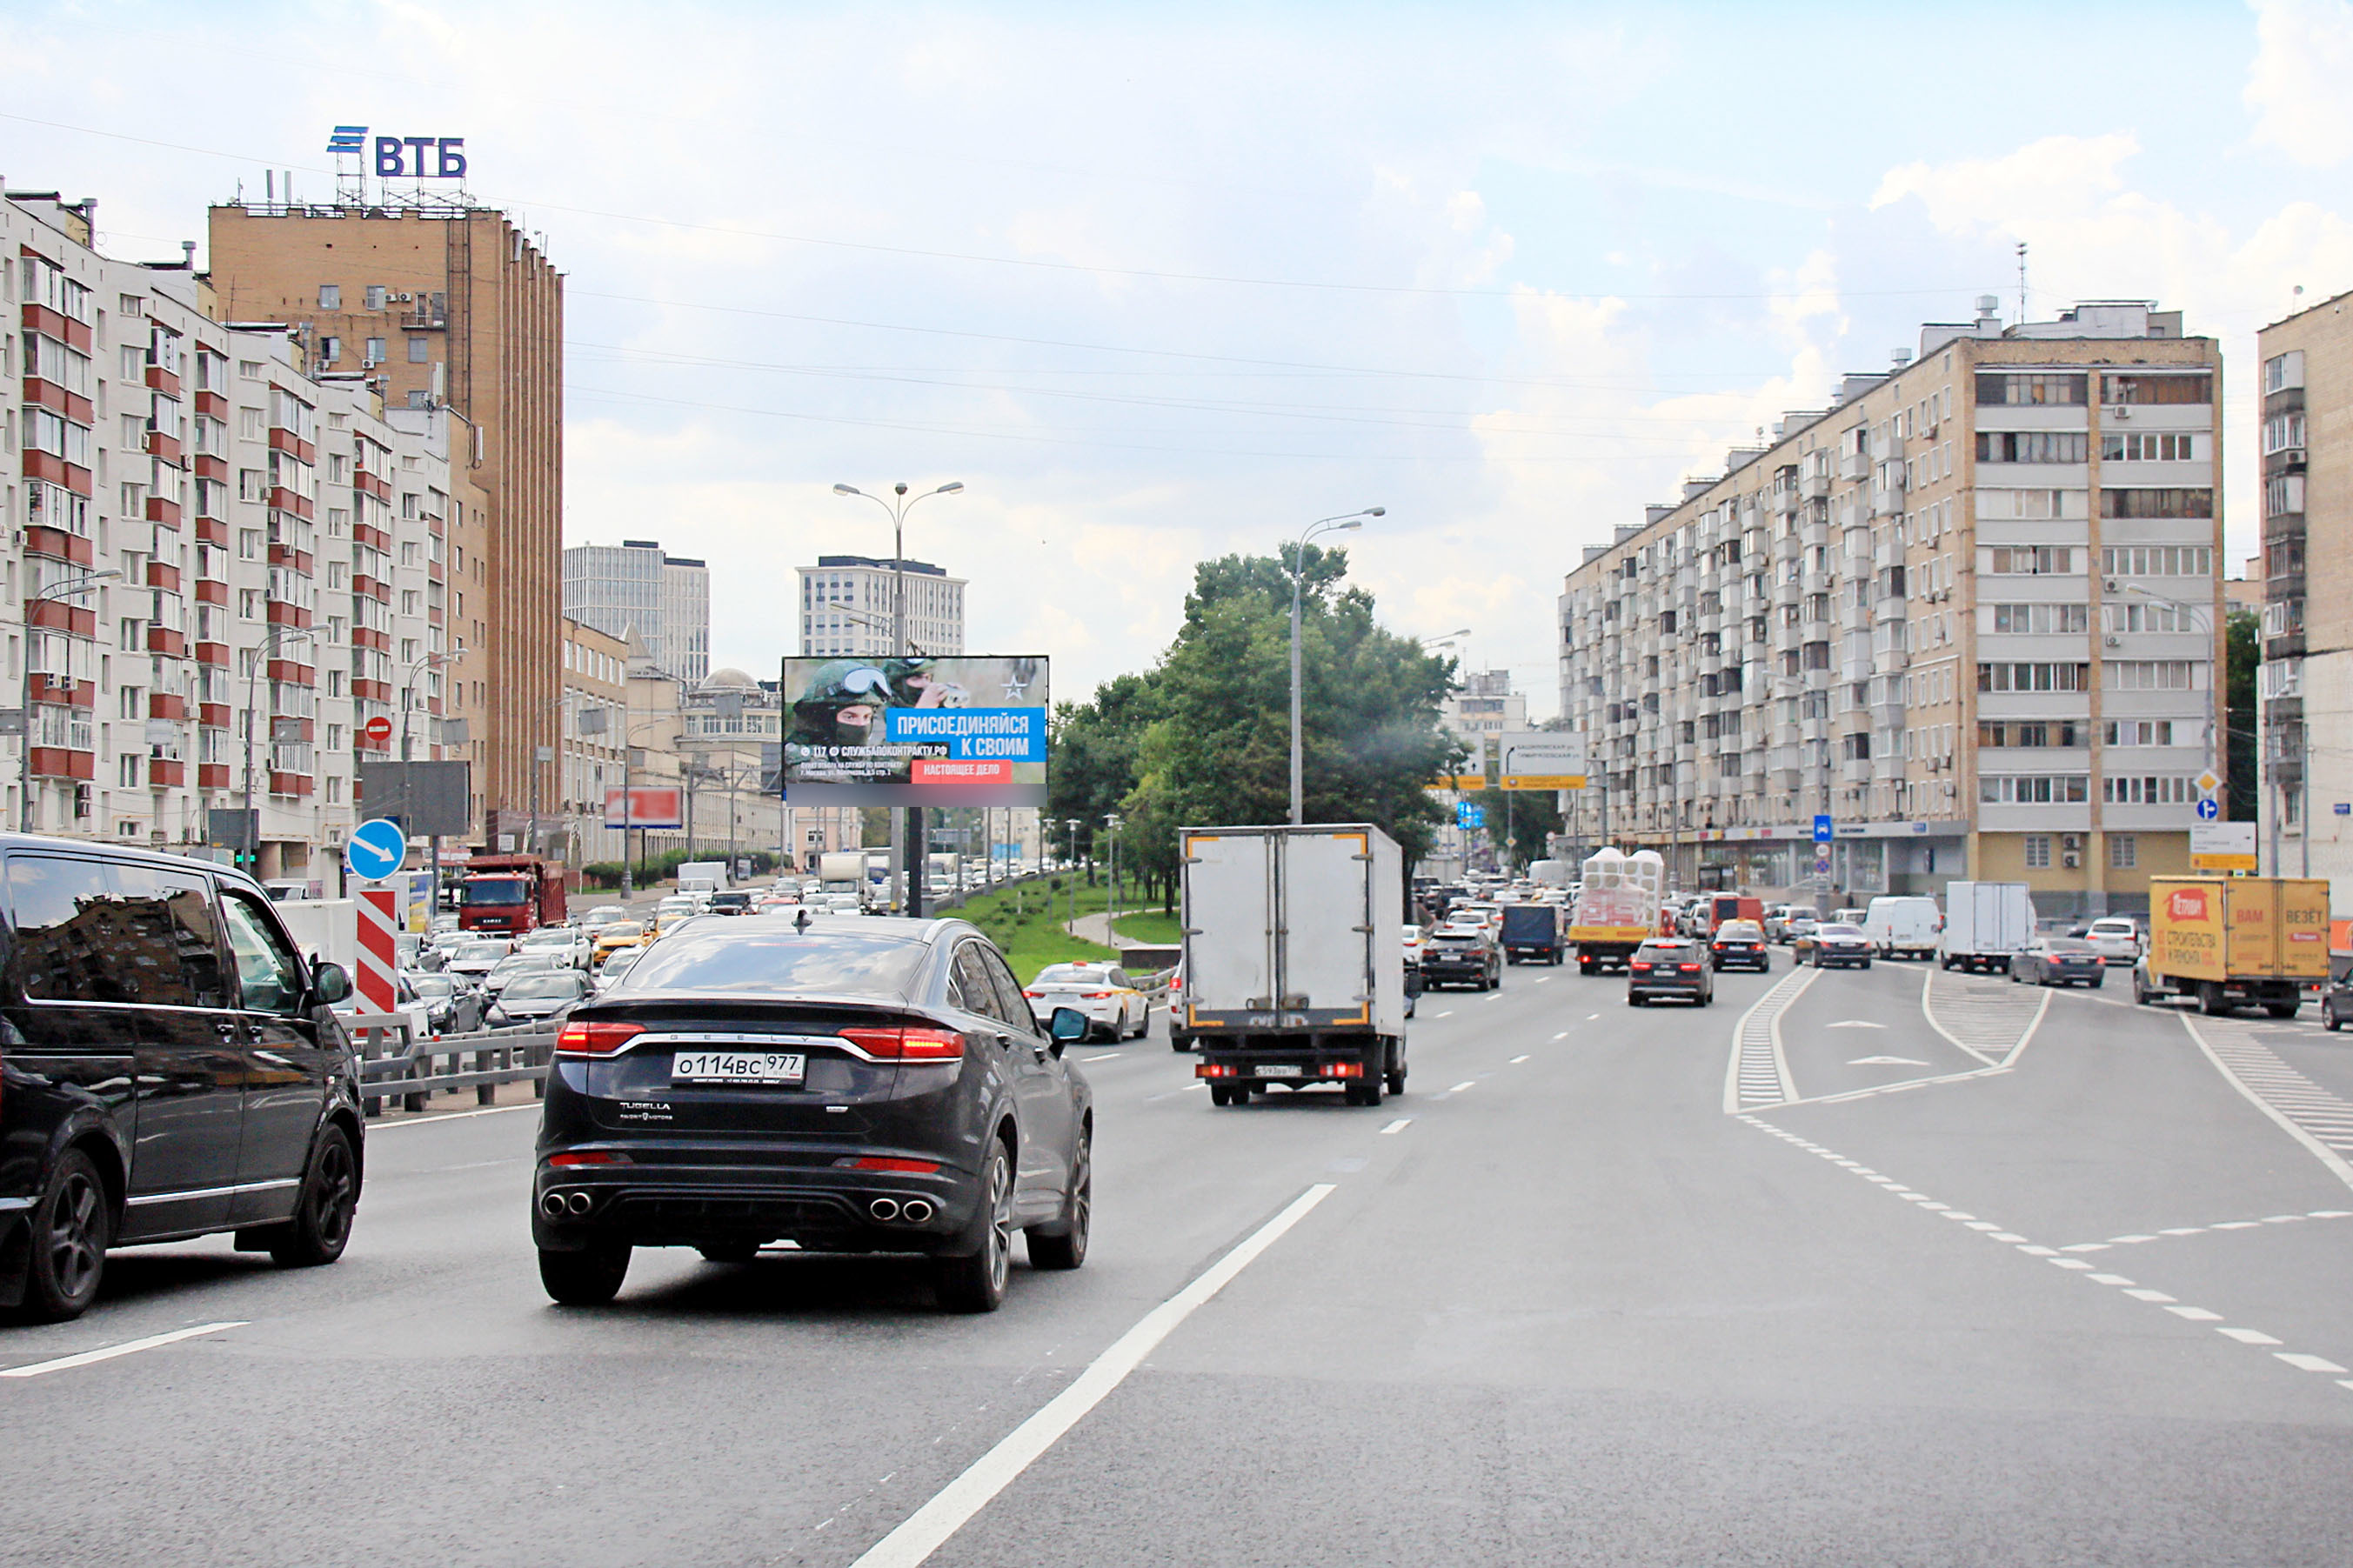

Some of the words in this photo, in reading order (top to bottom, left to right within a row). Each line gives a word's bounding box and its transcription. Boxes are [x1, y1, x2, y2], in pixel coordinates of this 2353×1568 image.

[376, 137, 467, 177] ВТБ
[898, 712, 1028, 736] ПРИСОЕДИНЯЙСЯ
[813, 746, 827, 756] 117
[841, 745, 947, 757] СЛУЖБАПОКОНТРАКТУ.РФ
[961, 737, 972, 756] К
[975, 737, 1029, 756] СВОИМ
[924, 764, 974, 776] НАСТОЯЩЕЕ
[975, 764, 1000, 776] ДЕЛО
[2236, 910, 2263, 924] ВАМ
[2286, 907, 2323, 924] ВЕЗЁТ
[767, 1056, 799, 1071] 977
[619, 1102, 671, 1111] TUGELLA
